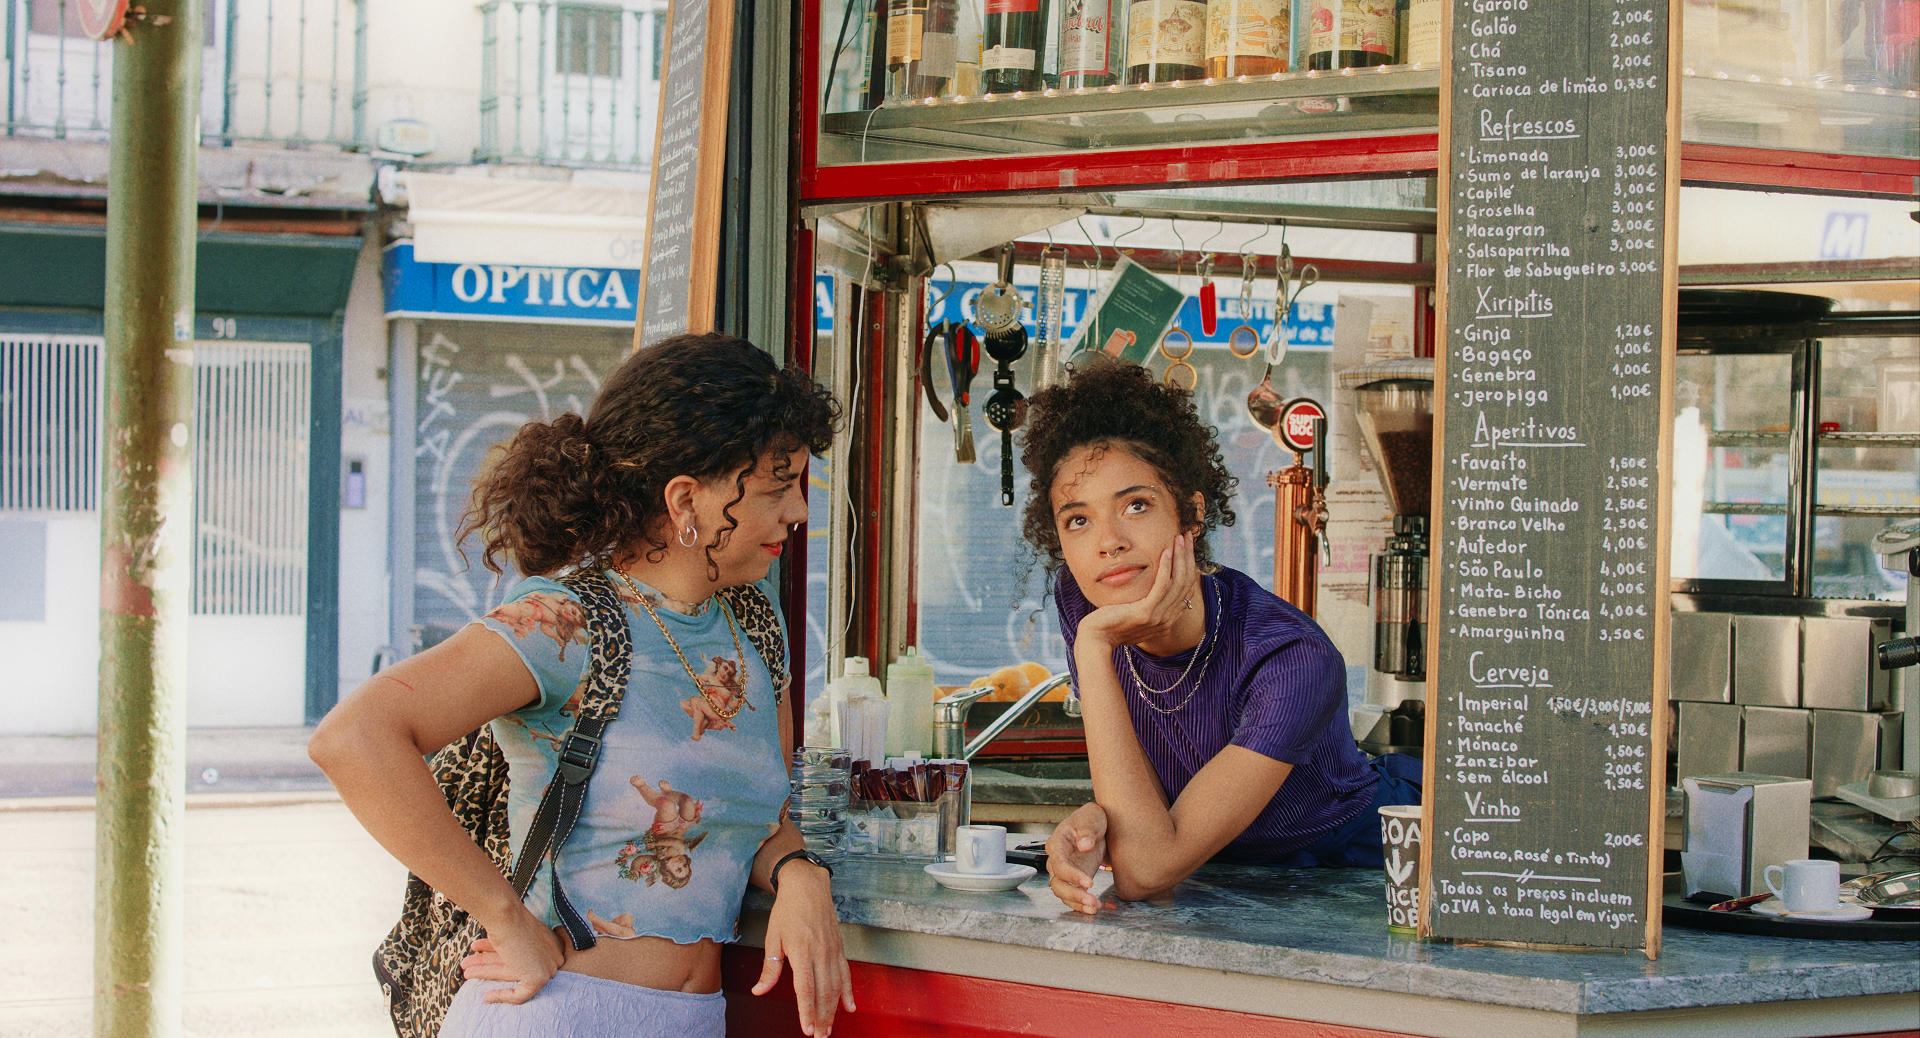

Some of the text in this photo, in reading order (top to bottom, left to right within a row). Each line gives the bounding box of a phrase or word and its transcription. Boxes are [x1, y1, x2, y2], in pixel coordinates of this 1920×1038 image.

[1472, 10, 1652, 36] Galão 2,00€
[1470, 32, 1652, 58] Chá 2,00€
[1470, 55, 1651, 77] Tisana 2,00€
[1473, 84, 1530, 97] Carioca
[1540, 80, 1558, 94] de
[1563, 76, 1607, 93] limão
[1480, 109, 1575, 141] Refrescos
[1469, 145, 1656, 164] Limonada 3,00€
[1468, 163, 1656, 183] Sumo de laranja 3,00€
[1467, 182, 1655, 203] Capilé 3,00€
[1467, 200, 1654, 219] Groselha 3,00€
[1467, 219, 1655, 241] Mazagran 3,00€
[1467, 239, 1654, 262] Salsaparrilha 3,00€
[1467, 261, 1657, 280] Flor de Sabugueiro 3,00€
[1476, 286, 1553, 319] Xiripitis
[212, 317, 237, 339] 90
[1464, 324, 1652, 345] Ginja 1,20€
[1463, 342, 1651, 366] Bagaço 1,00€
[1462, 363, 1650, 383] Genebra 1,00€
[1611, 384, 1651, 400] 1,00€
[1290, 425, 1314, 436] BOC
[1475, 411, 1576, 449] Aperitivos
[1610, 457, 1646, 472] 1,50€
[1458, 475, 1648, 491] Vermute 2,50€
[1458, 496, 1647, 513] Vinho Quinado 2,50€
[1458, 516, 1648, 532] Branco Velho 2,50€
[1457, 534, 1646, 554] Autedor 4,00€
[1460, 559, 1646, 578] São Paulo 4,00€
[1601, 582, 1645, 596] 4,00€
[1459, 603, 1647, 620] Genebra Tónica 4,00€
[1459, 624, 1644, 643] Amarguinha 3,50€
[1470, 651, 1548, 687] Cerveja
[1459, 692, 1528, 714] Imperial
[1458, 715, 1647, 738] Panaché 1,50€
[1605, 745, 1644, 759] 1,50€
[1455, 755, 1642, 777] Zanzibar 2,00€
[1502, 769, 1547, 784] álcool
[1604, 778, 1644, 790] 1,50€
[1465, 792, 1520, 816] Vinho
[1454, 827, 1643, 847] Copo 2,00€
[1555, 855, 1562, 864] e
[1567, 851, 1610, 868] Tinto)
[1441, 880, 1632, 905] Todos os preços incluem
[1486, 899, 1496, 914] à
[1502, 902, 1533, 917] taxa
[1541, 904, 1573, 924] legal
[1577, 910, 1595, 922] em
[1598, 910, 1637, 929] vigor.
